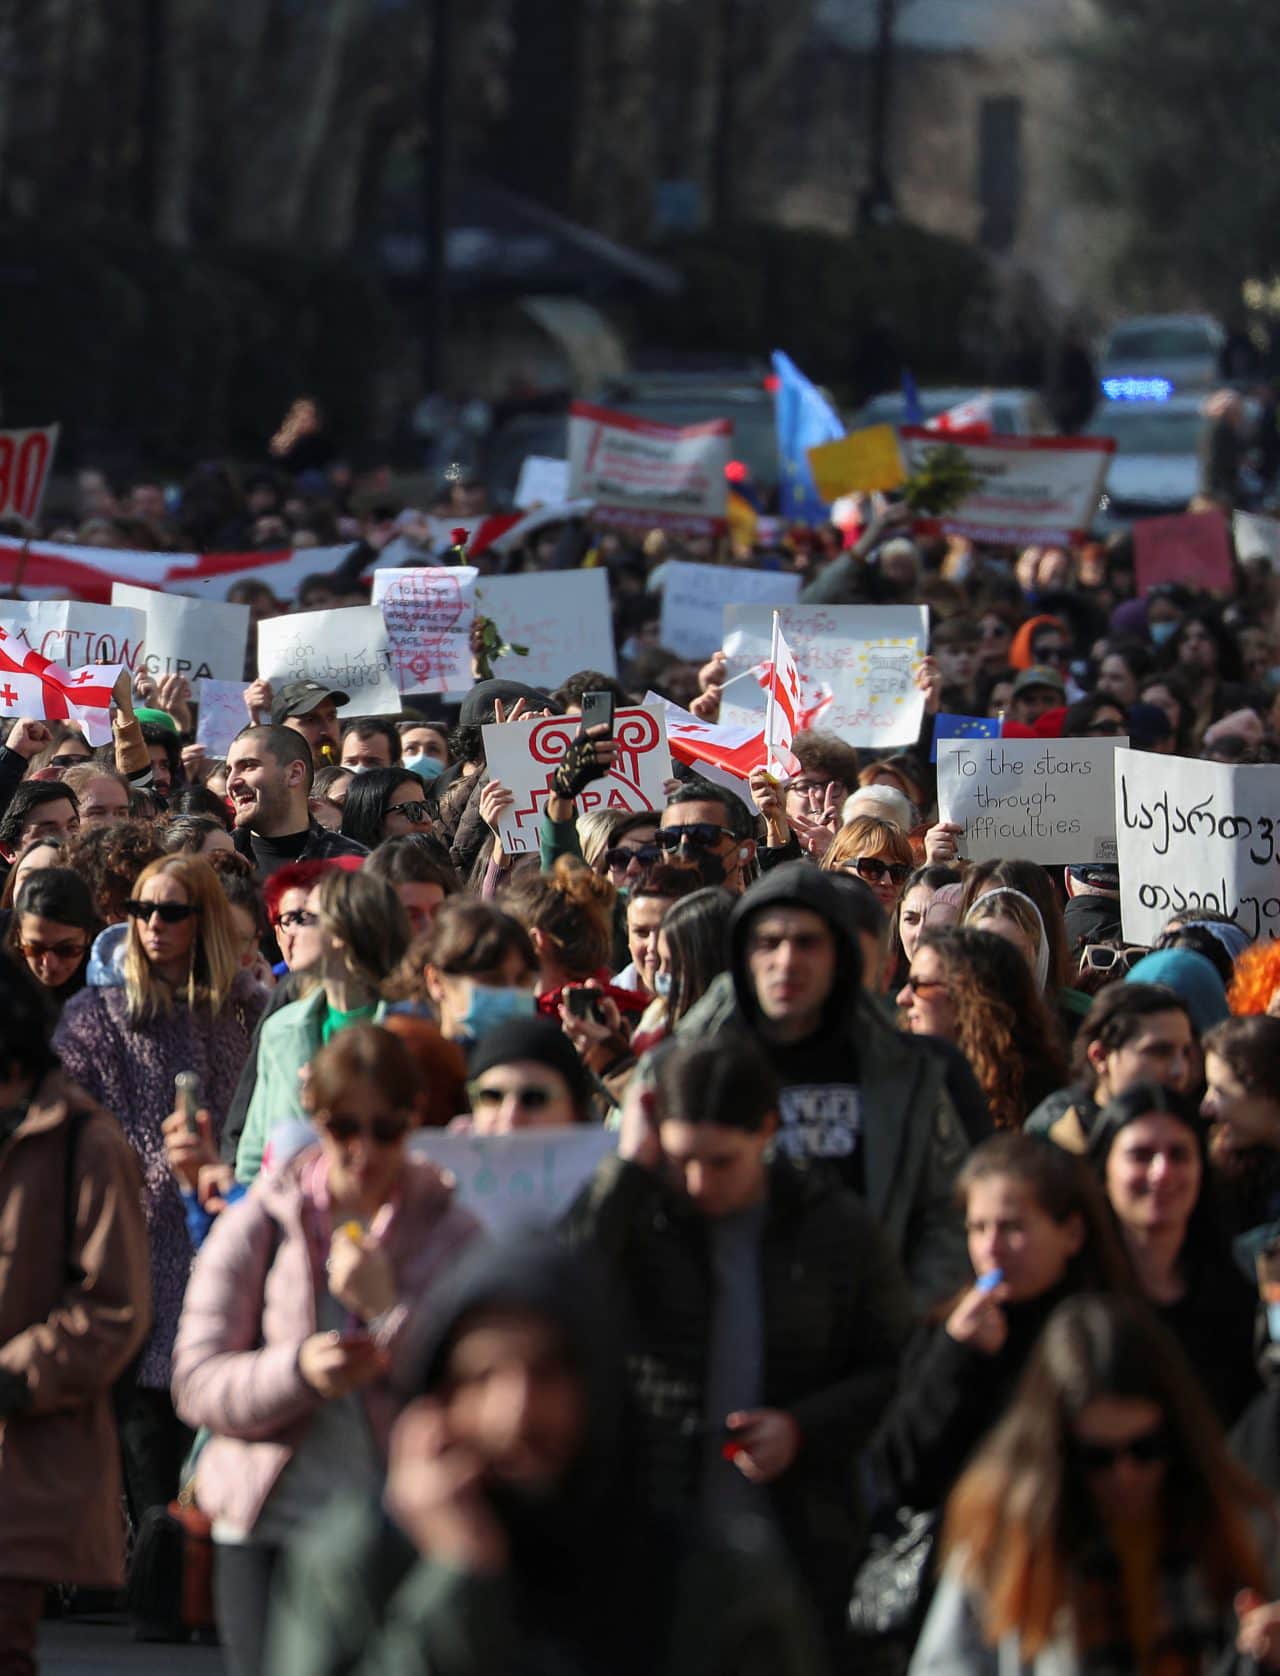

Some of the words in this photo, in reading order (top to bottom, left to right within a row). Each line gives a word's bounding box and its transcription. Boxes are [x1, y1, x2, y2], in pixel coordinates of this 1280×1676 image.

[144, 654, 215, 682] GIPA
[949, 750, 977, 776] To
[986, 748, 1024, 776] the
[1033, 748, 1092, 775] stars
[974, 782, 1056, 817] through
[957, 815, 1081, 841] difficulties
[1122, 774, 1280, 866] საქართვ
